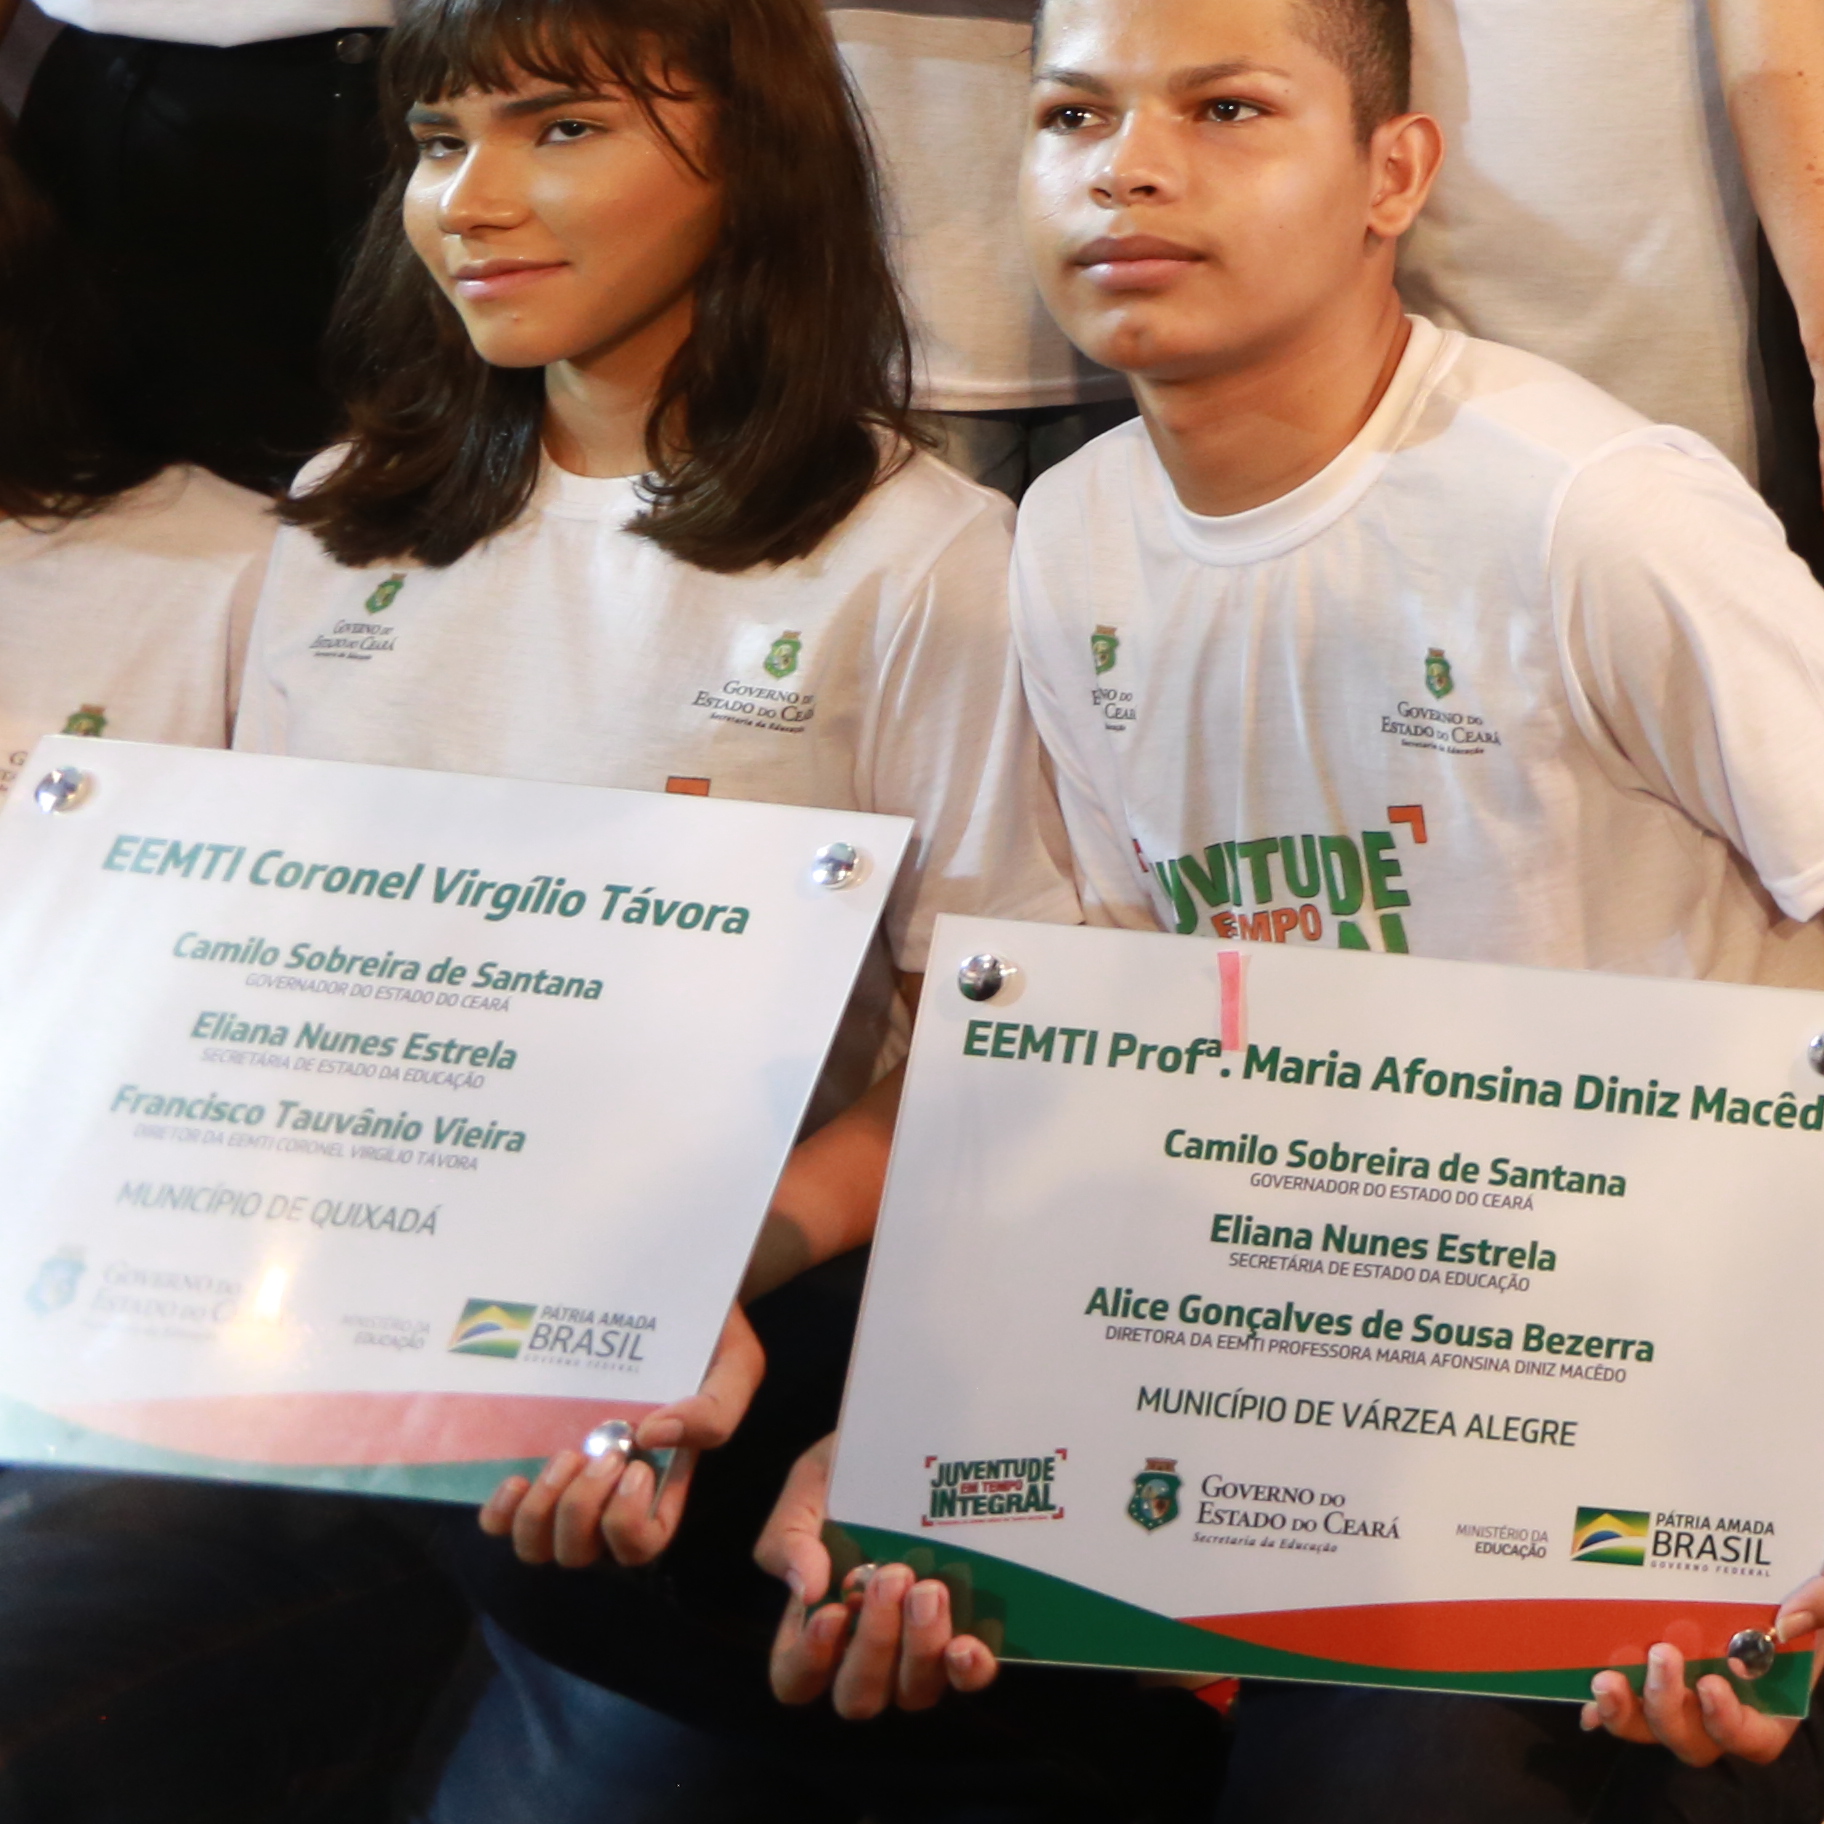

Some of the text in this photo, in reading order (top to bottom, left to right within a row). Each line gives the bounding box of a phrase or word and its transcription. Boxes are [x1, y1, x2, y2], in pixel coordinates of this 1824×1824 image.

[104, 837, 750, 935] EEMTI Coronel Virgílio Távora
[963, 1020, 1098, 1065] EEMTI
[1243, 1044, 1361, 1089] Maria
[1370, 1057, 1562, 1108] Afonsina
[1574, 1074, 1680, 1118] Diniz
[110, 1085, 526, 1153] Francisco Tauvânio Vieira
[119, 1182, 442, 1236] MUNICÍPIO DE QUIXADÁ
[1250, 1173, 1533, 1211] GOVERNADOR DO ESTADO DO CEARÁ
[1084, 1287, 1654, 1362] Alice Gonçalves de Sousa Bezerra
[1137, 1386, 1578, 1447] MUNICÍPIO DE VÁRZEA ALEGRE
[1651, 1529, 1773, 1567] BRASIL
